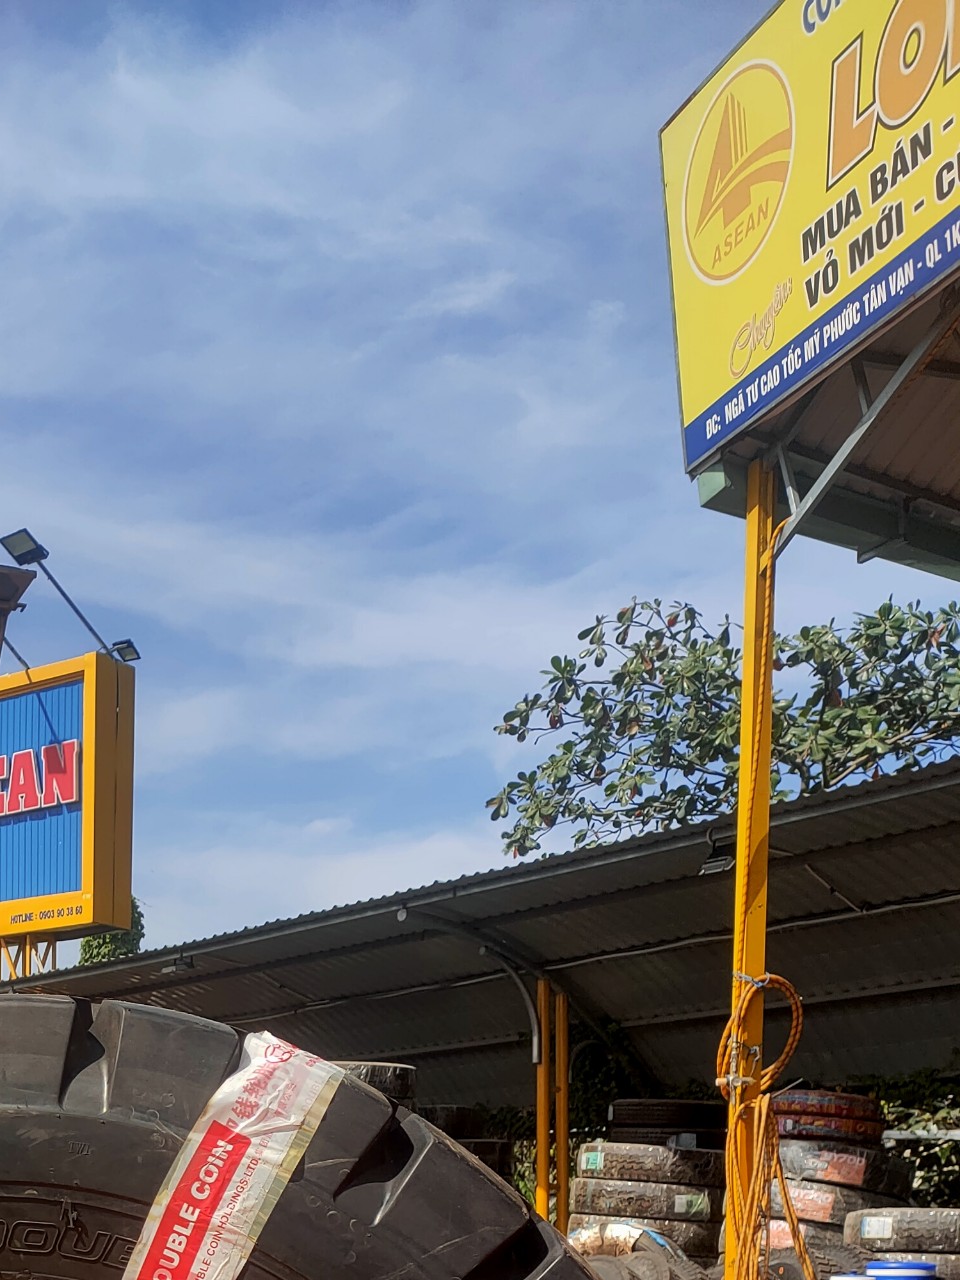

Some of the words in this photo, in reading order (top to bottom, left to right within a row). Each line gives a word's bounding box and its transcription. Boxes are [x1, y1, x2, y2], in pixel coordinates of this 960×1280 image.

[801, 187, 862, 263] MUA
[869, 121, 932, 203] BÁN
[805, 248, 839, 309] VỎ
[848, 200, 904, 275] MỚI
[935, 150, 960, 200] C
[711, 198, 769, 270] ASEAN
[746, 378, 759, 407] TƯ
[760, 364, 780, 396] CAO
[781, 344, 802, 379] TỐC
[803, 327, 821, 363] MỸ
[822, 301, 861, 348] PHƯỚC
[862, 280, 887, 316] TÂN
[888, 258, 915, 295] VẠN
[925, 238, 942, 269] QL
[10, 912, 34, 925] HOTLINE
[39, 909, 55, 921] 0903
[56, 908, 65, 918] 90
[66, 906, 74, 917] 38
[190, 1139, 234, 1201] COIN
[206, 1228, 224, 1259] COIN
[217, 1180, 248, 1231] HOLDINGS
